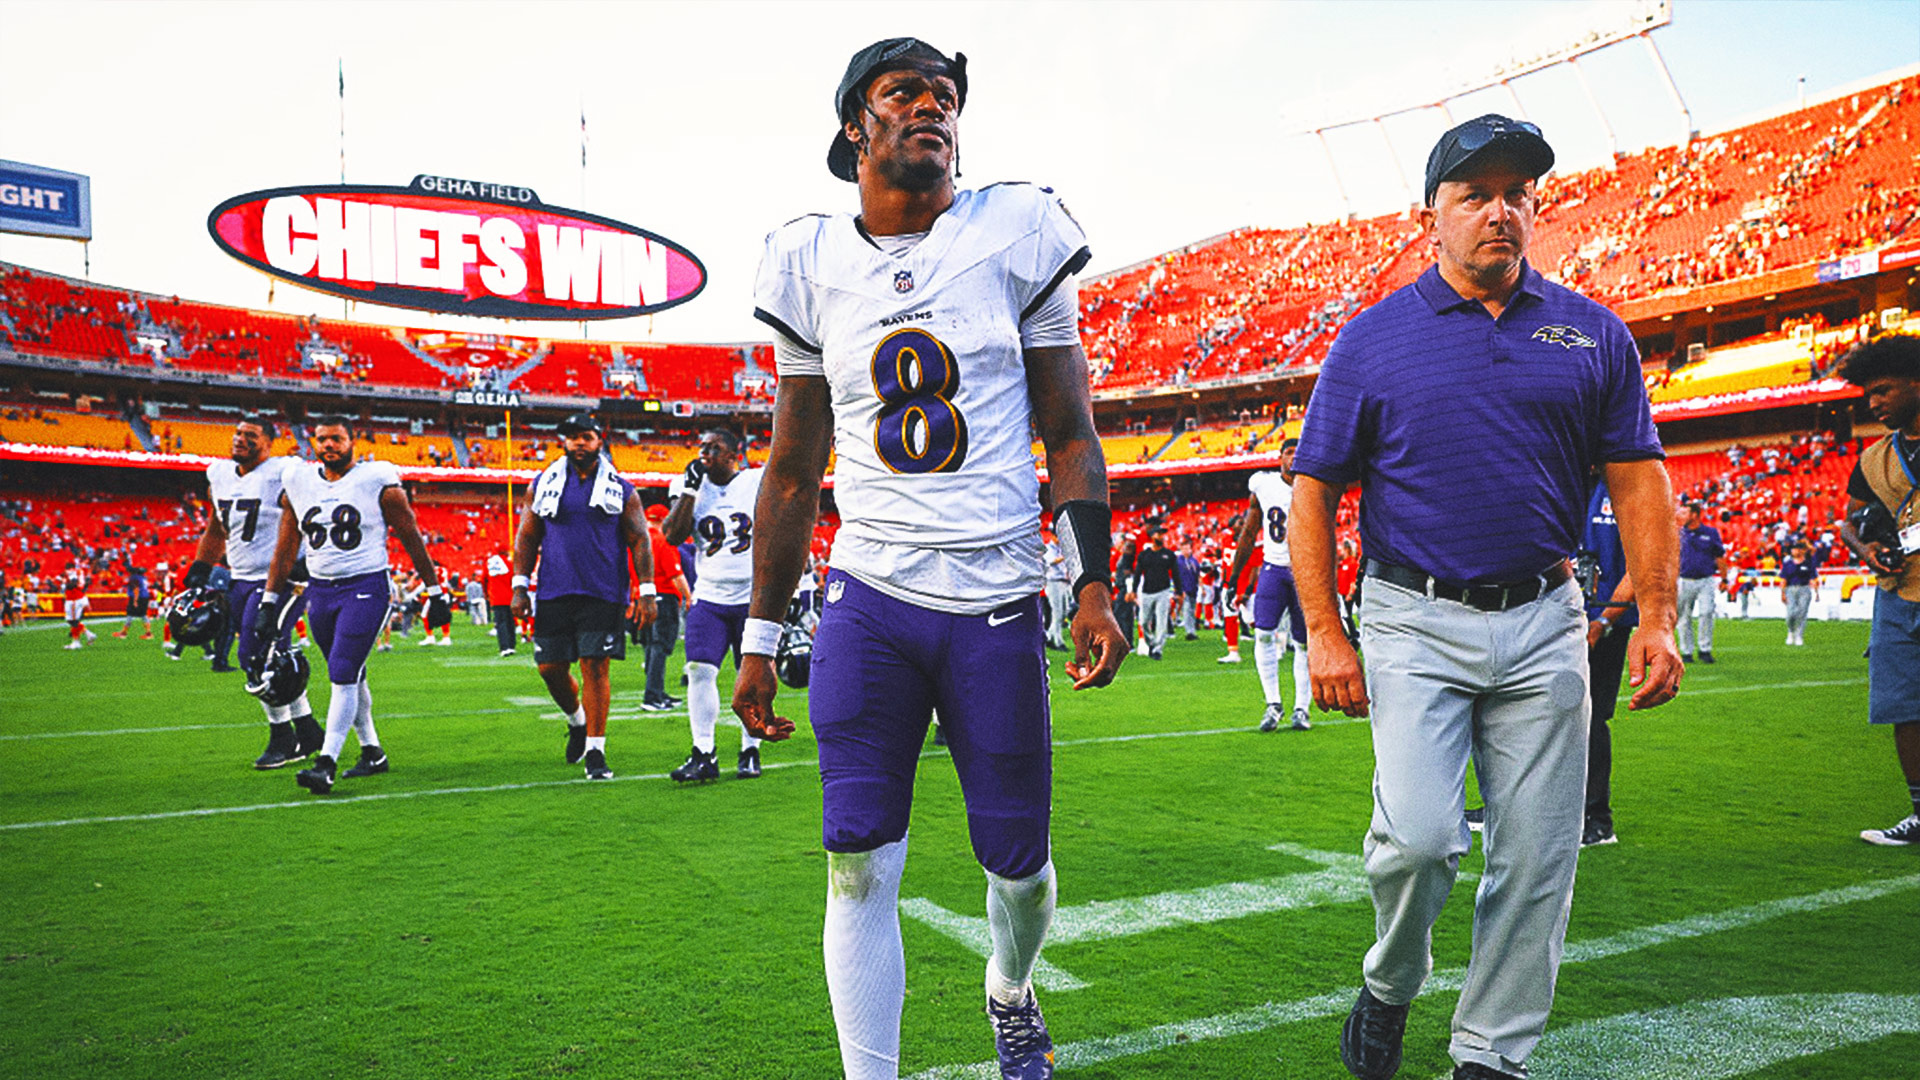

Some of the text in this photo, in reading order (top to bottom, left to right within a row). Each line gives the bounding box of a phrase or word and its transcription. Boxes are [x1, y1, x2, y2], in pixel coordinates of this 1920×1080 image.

[0, 184, 64, 211] GHT
[420, 176, 532, 203] GEHA FIELD
[262, 194, 669, 308] CHIEFS WIN
[879, 310, 933, 327] RAVENS
[871, 328, 968, 473] 8
[302, 504, 363, 550] 68
[698, 512, 753, 557] 93
